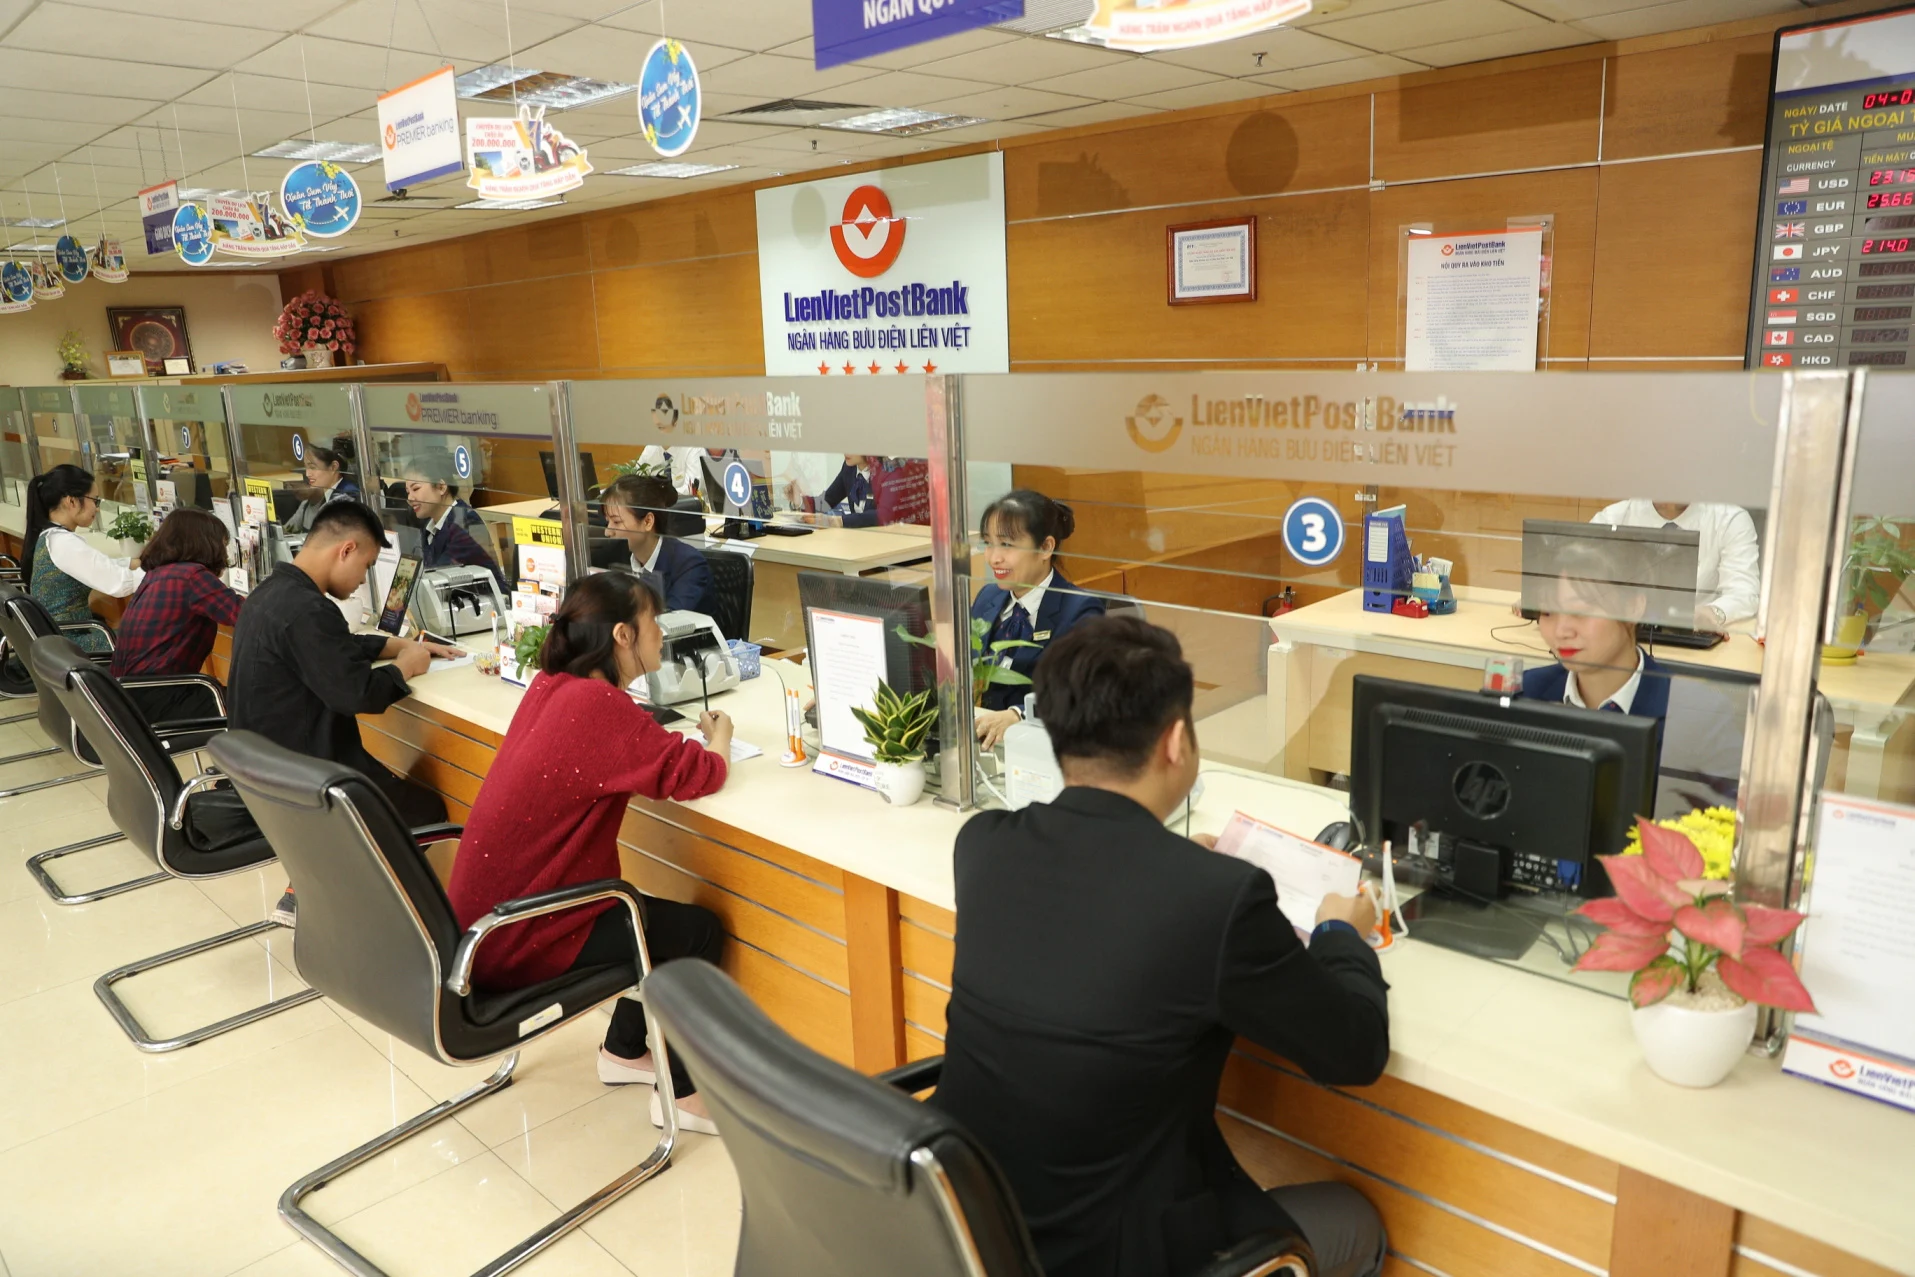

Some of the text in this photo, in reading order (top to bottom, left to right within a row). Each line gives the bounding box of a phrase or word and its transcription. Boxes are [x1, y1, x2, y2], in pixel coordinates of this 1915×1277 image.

[1819, 102, 1848, 114] DATE
[1790, 119, 1810, 137] TỶ
[1814, 115, 1843, 135] GIÁ
[1848, 110, 1905, 130] NGOẠI
[396, 118, 454, 148] PREMIER banking
[1897, 131, 1915, 143] MU
[472, 138, 517, 148] 200.000.000
[1788, 139, 1835, 155] NGOẠI TỆ
[1786, 160, 1836, 173] CURRENCY
[1818, 178, 1849, 190] USD
[1816, 201, 1846, 212] EUR
[211, 208, 250, 221] 200.000.000
[1814, 223, 1844, 235] GBP
[1812, 245, 1841, 257] JPY
[1810, 268, 1843, 279] AUD
[783, 280, 969, 323] LienVietPostBank
[1807, 290, 1836, 301] CHF
[1806, 312, 1836, 322] SGD
[787, 322, 971, 352] NGÂN HÀNG BƯU ĐIỆN LIÊN VIỆT
[1803, 333, 1834, 344] CAD
[1800, 355, 1831, 365] HKD
[422, 408, 498, 430] PREMIER banking
[295, 441, 302, 456] 6
[1191, 434, 1231, 458] NGÂN
[459, 452, 467, 473] 5
[731, 472, 745, 498] 4
[530, 524, 562, 537] WESTERN
[1301, 513, 1327, 552] 3
[541, 535, 564, 546] UNION
[1459, 763, 1509, 813] hp
